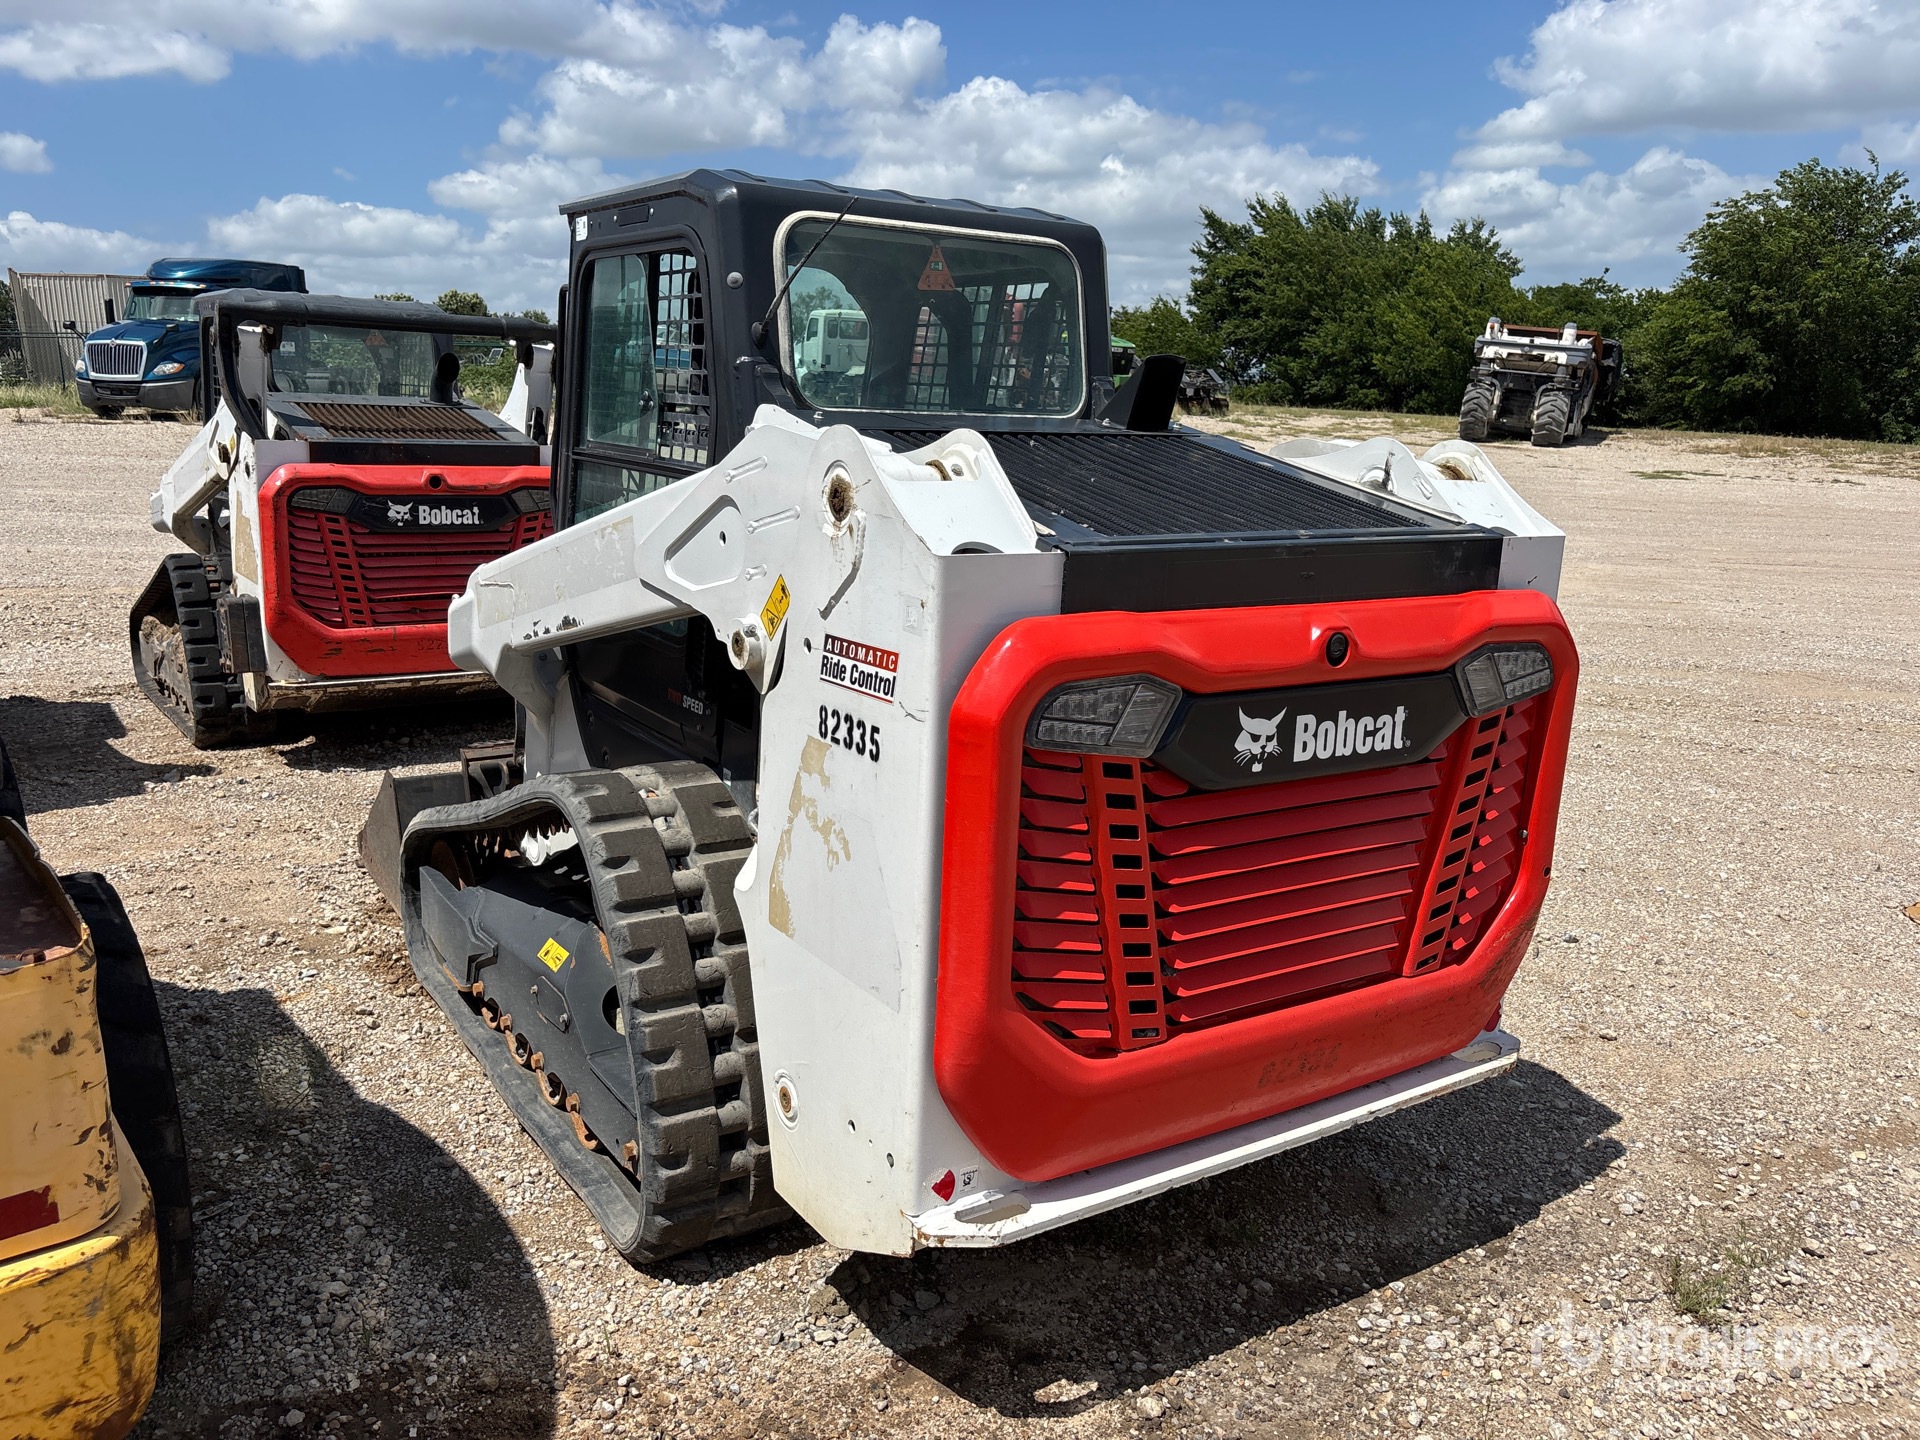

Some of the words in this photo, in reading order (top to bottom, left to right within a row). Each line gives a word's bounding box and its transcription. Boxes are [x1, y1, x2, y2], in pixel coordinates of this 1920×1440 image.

[418, 505, 480, 525] Bobcat
[826, 637, 896, 670] AUTOMATIC
[820, 654, 847, 682] Ride
[849, 663, 897, 698] Control
[682, 694, 704, 715] SPEED
[818, 704, 881, 763] 82335
[1293, 705, 1406, 763] Bobcat
